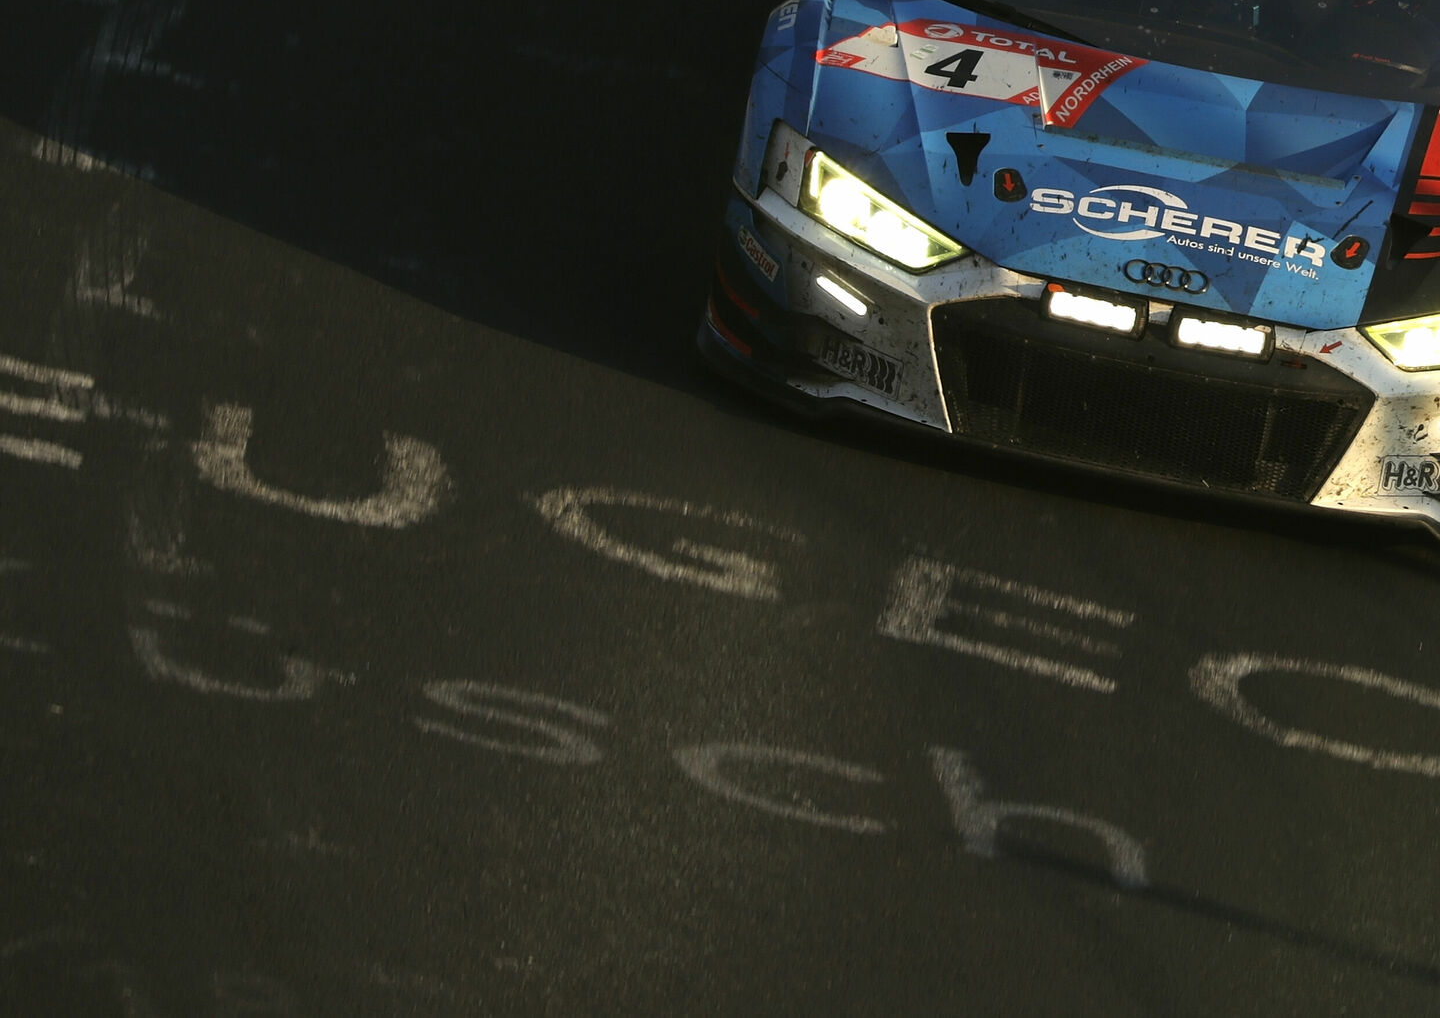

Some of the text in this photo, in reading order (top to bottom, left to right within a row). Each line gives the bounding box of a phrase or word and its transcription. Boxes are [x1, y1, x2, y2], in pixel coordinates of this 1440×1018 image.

[971, 29, 1078, 65] TOTAL
[924, 48, 985, 89] 4
[1055, 55, 1134, 123] NORDRHEIN
[1029, 185, 1328, 268] SCHERER
[745, 237, 776, 279] Castrol
[1166, 234, 1321, 281] Autos sind unsere Welt.
[1382, 460, 1438, 493] H&R
